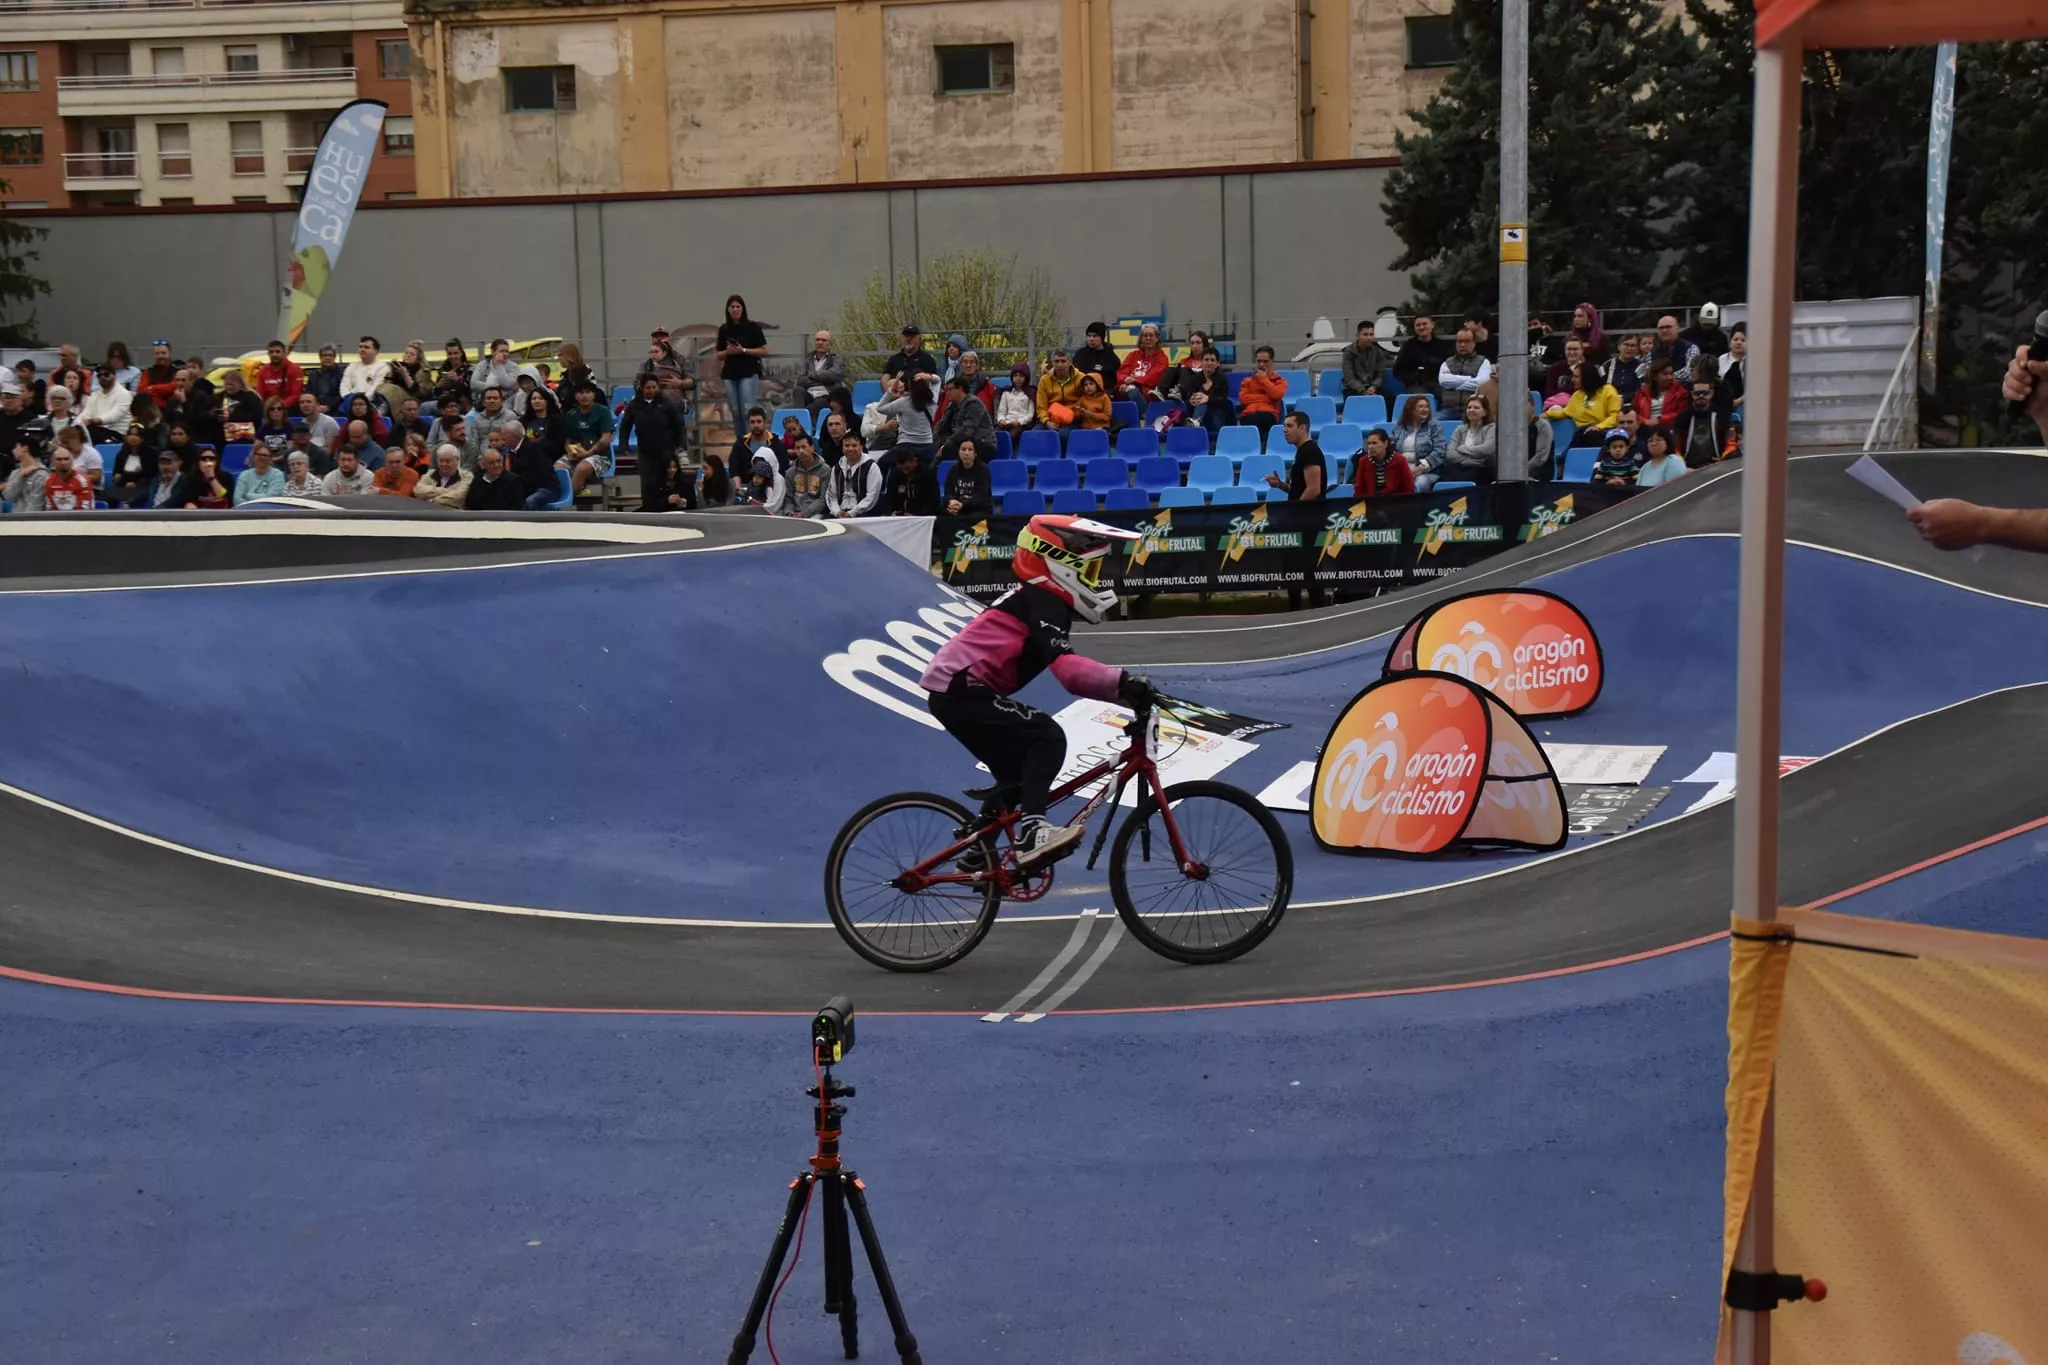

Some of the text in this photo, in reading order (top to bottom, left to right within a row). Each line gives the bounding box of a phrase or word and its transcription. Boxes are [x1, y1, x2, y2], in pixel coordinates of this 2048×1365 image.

[1228, 516, 1270, 539] Sport
[1324, 512, 1368, 535] Sport
[1424, 508, 1469, 531] Sport
[1529, 504, 1576, 528] Sport
[953, 530, 991, 551] Sport
[1135, 521, 1173, 544] Sport
[1240, 533, 1299, 548] BIOFRUTAL
[1338, 530, 1398, 545] BIOFRUTAL
[1438, 527, 1499, 542] BIOFRUTAL
[1145, 538, 1202, 552] BIOFRUTAL
[1123, 576, 1207, 587] WWW.BIOFRUTAL.COM
[1217, 571, 1304, 583] WWW.BIOFRUTAL.COM
[1313, 568, 1403, 580] WWW.BIOFRUTAL.COM
[1513, 634, 1585, 666] aragón
[1504, 664, 1589, 691] ciclismo
[1404, 744, 1477, 785] aragón
[1382, 786, 1466, 815] ciclismo
